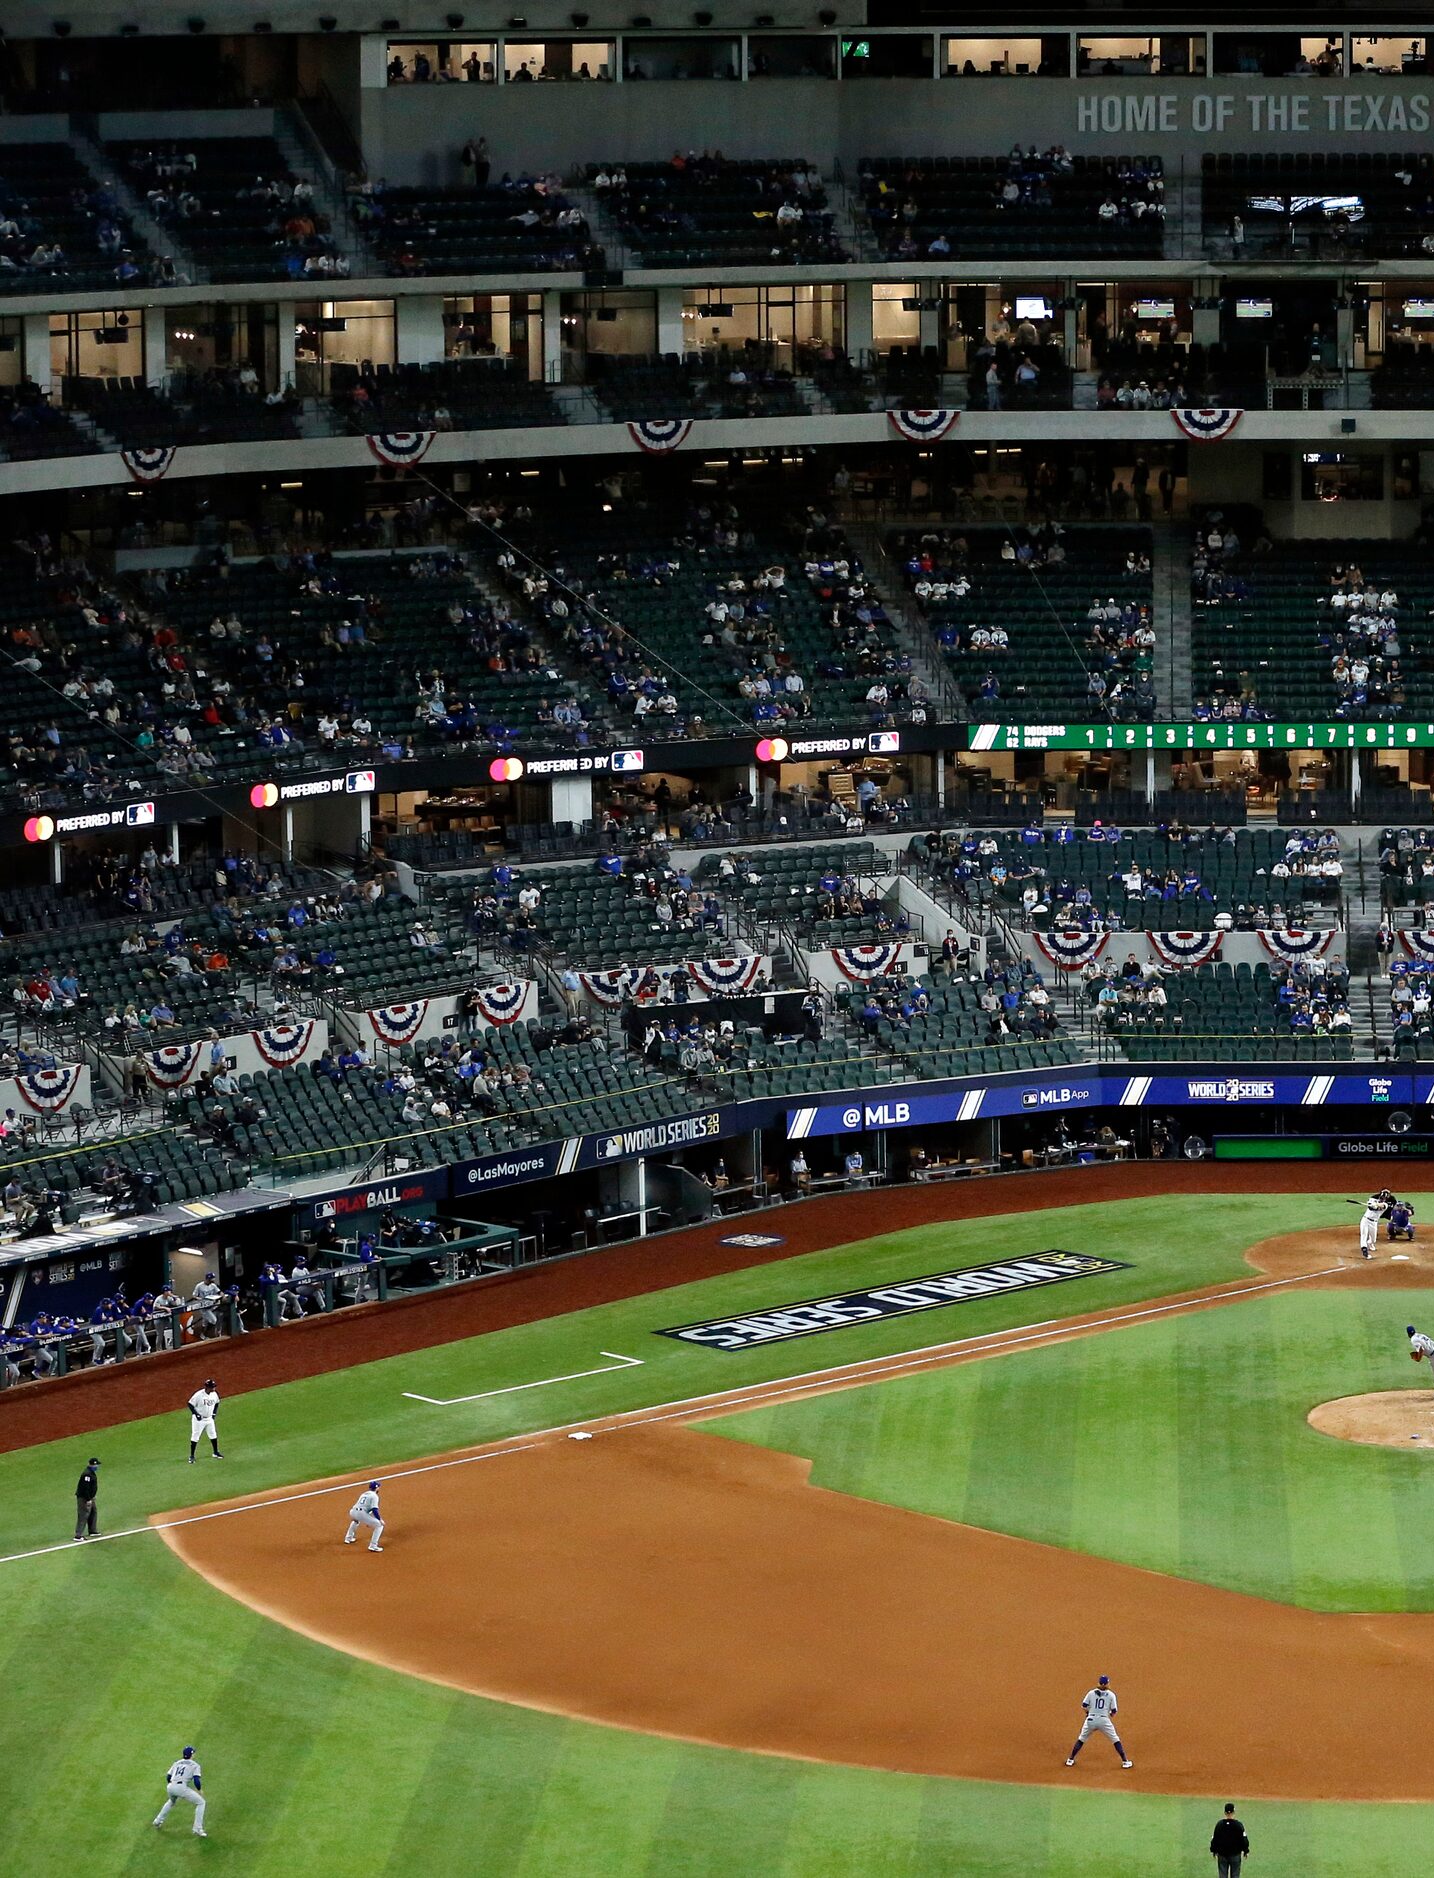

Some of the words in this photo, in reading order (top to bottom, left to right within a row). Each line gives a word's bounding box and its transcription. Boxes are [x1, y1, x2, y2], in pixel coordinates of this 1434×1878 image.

[1077, 95, 1177, 132] HOME
[1191, 95, 1234, 132] OF
[1246, 95, 1309, 132] THE
[1322, 95, 1429, 132] TEXAS
[1006, 726, 1019, 736] 74
[1024, 726, 1065, 736] DODGERS
[1107, 726, 1113, 736] 1
[1147, 726, 1153, 735] 0
[1187, 725, 1194, 735] 2
[1227, 725, 1234, 735] 2
[1267, 725, 1273, 735] 0
[1308, 725, 1313, 735] 1
[1348, 725, 1354, 734] 0
[1388, 725, 1394, 734] 0
[1428, 725, 1434, 734] 0
[1086, 729, 1094, 744] 1
[1126, 729, 1136, 744] 2
[1165, 729, 1175, 744] 3
[1206, 729, 1216, 744] 4
[1246, 728, 1256, 743] 5
[1287, 728, 1296, 743] 6
[1327, 728, 1336, 743] 7
[1366, 728, 1376, 743] 8
[1406, 728, 1416, 743] 9
[792, 739, 850, 754] PREFERRED
[852, 738, 866, 750] BY
[1006, 737, 1019, 748] 62
[1024, 737, 1048, 748] RAYS
[1107, 738, 1113, 748] 0
[1147, 738, 1153, 747] 0
[1187, 738, 1193, 747] 0
[1227, 738, 1234, 747] 0
[1267, 737, 1273, 747] 1
[1307, 737, 1313, 747] 0
[1348, 737, 1354, 746] 0
[1388, 737, 1394, 746] 0
[527, 758, 593, 773] PREFERRED
[594, 757, 609, 768] BY
[281, 781, 331, 798] PREFERRED
[331, 779, 345, 791] BY
[57, 813, 110, 832] PREFERRED
[111, 811, 125, 824] BY
[894, 963, 901, 971] 15
[447, 1017, 454, 1025] 17
[1368, 1079, 1392, 1087] Globe
[1040, 1088, 1070, 1105] MLB
[1071, 1090, 1089, 1100] App
[1188, 1083, 1225, 1097] WORLD
[1238, 1083, 1274, 1097] SERIES
[1372, 1086, 1387, 1094] Life
[1371, 1094, 1389, 1102] Field
[707, 1112, 720, 1125] 20
[624, 1122, 666, 1154] WORLD
[668, 1115, 708, 1144] SERIES
[707, 1123, 720, 1135] 20
[1338, 1142, 1373, 1152] Globe
[1376, 1142, 1398, 1152] Life
[1401, 1142, 1428, 1152] Field
[468, 1158, 545, 1183] @LasMayores
[336, 1186, 424, 1214] PLAYBALL.ORG
[80, 1260, 103, 1272] @MLB
[867, 1262, 1084, 1306] WORLD
[678, 1300, 882, 1347] SERIES
[1095, 1698, 1105, 1709] 10
[175, 1766, 186, 1776] 14
